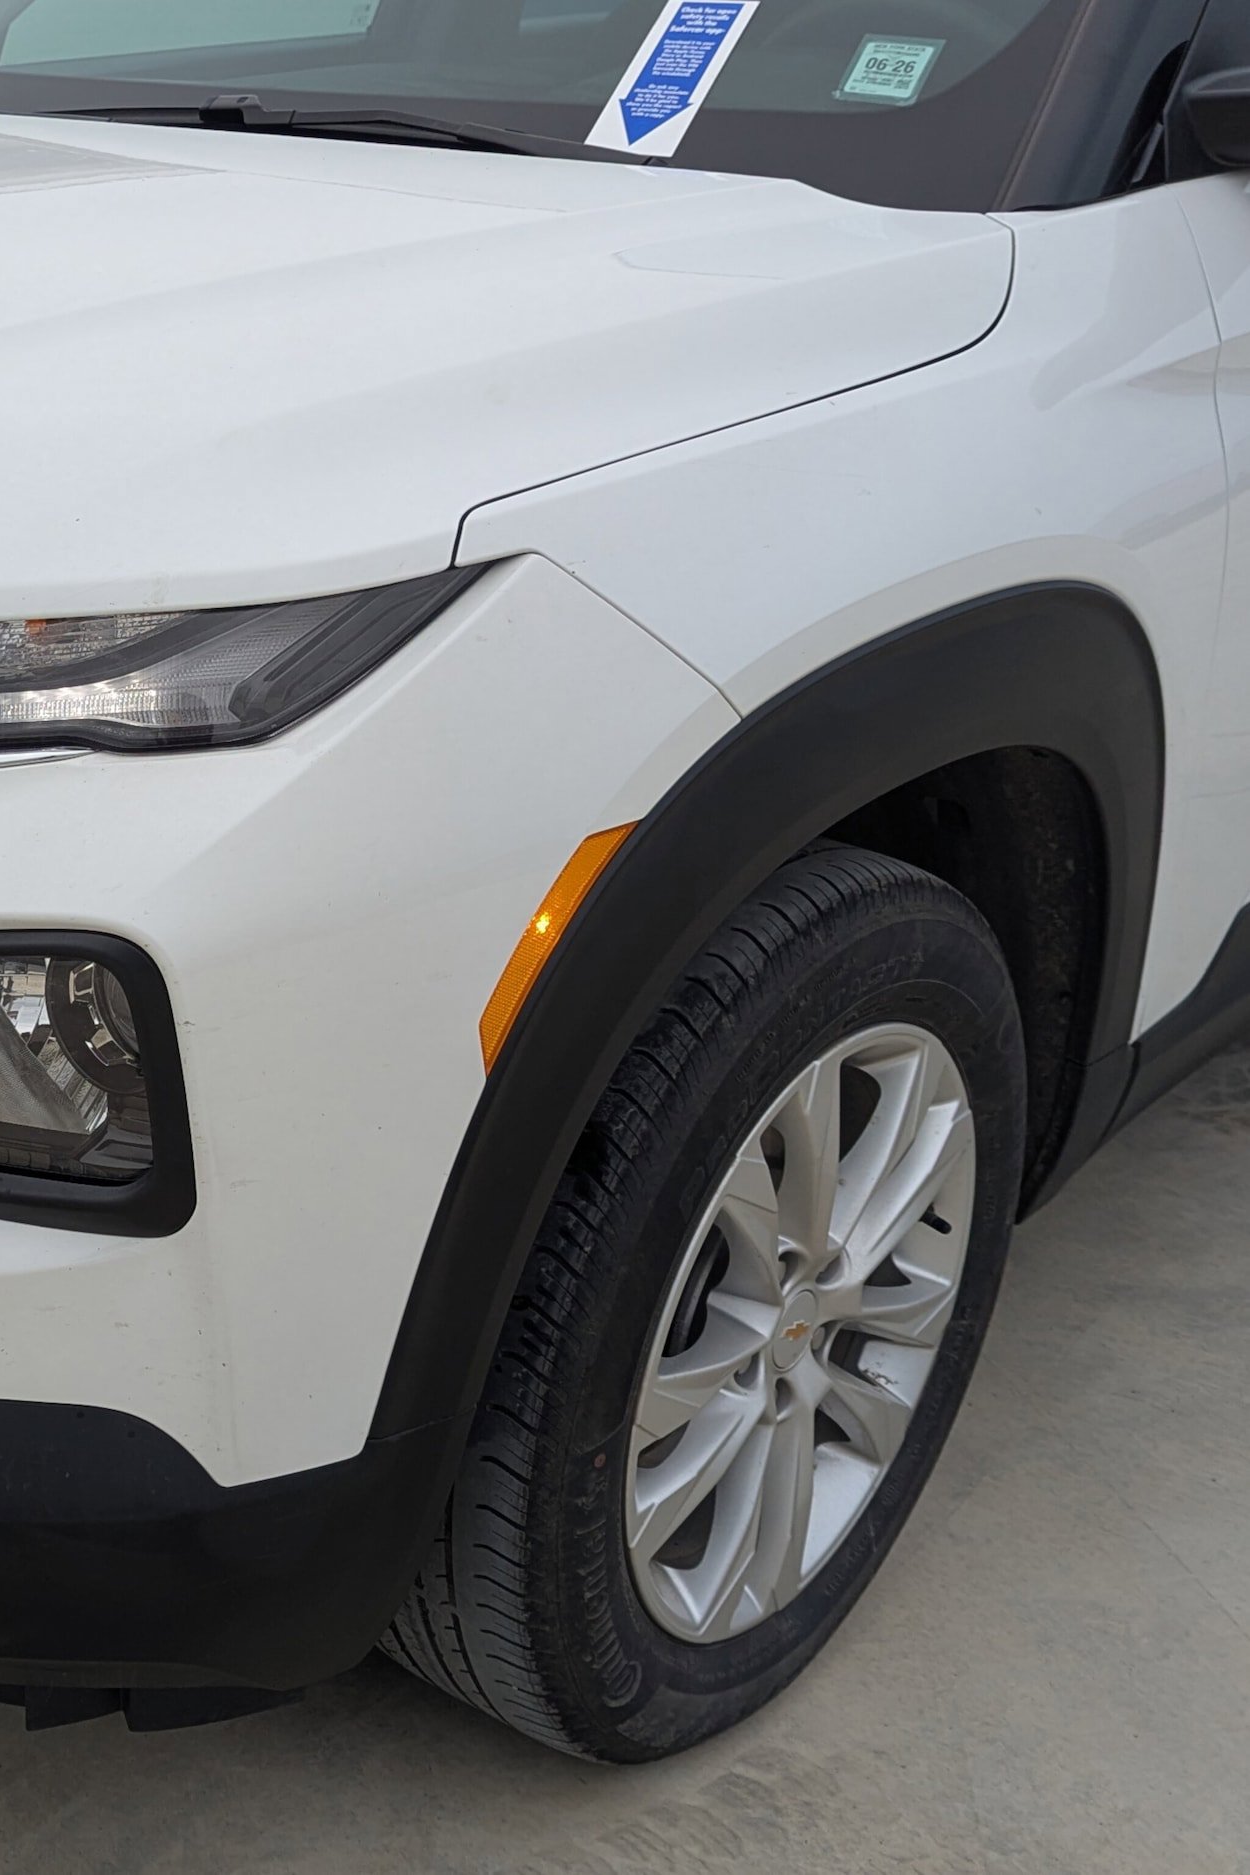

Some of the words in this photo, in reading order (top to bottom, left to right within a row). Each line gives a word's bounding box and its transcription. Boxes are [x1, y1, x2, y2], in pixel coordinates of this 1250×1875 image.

[681, 6, 703, 14] Check
[704, 6, 716, 14] for
[865, 57, 888, 71] 06
[892, 59, 917, 74] 26
